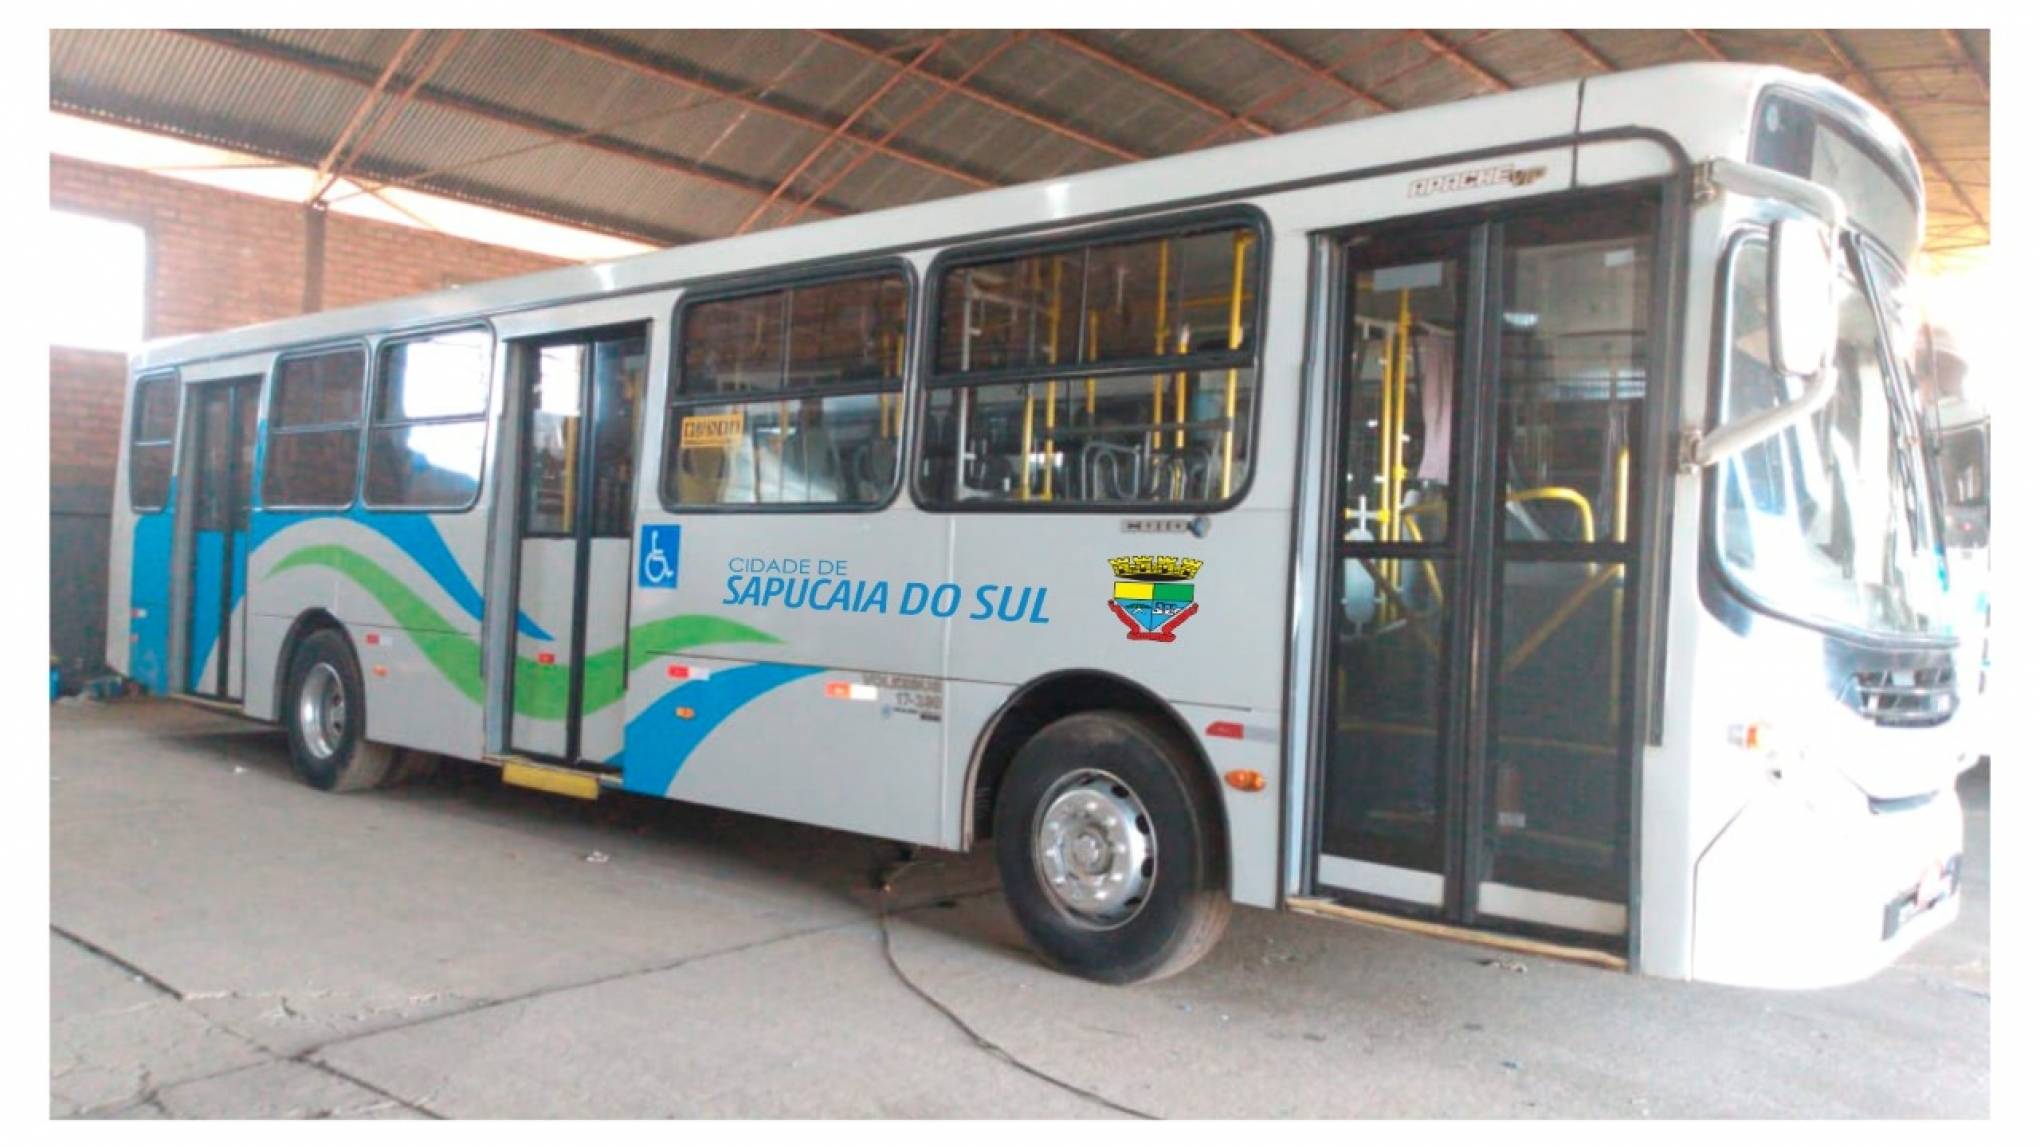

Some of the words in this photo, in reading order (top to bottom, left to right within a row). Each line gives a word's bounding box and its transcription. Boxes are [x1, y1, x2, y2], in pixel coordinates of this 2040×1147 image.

[728, 557, 812, 575] CIDADE
[817, 559, 848, 576] DE
[722, 575, 889, 614] SAPUCAIA
[898, 582, 962, 618] DO
[969, 584, 1050, 624] SUL
